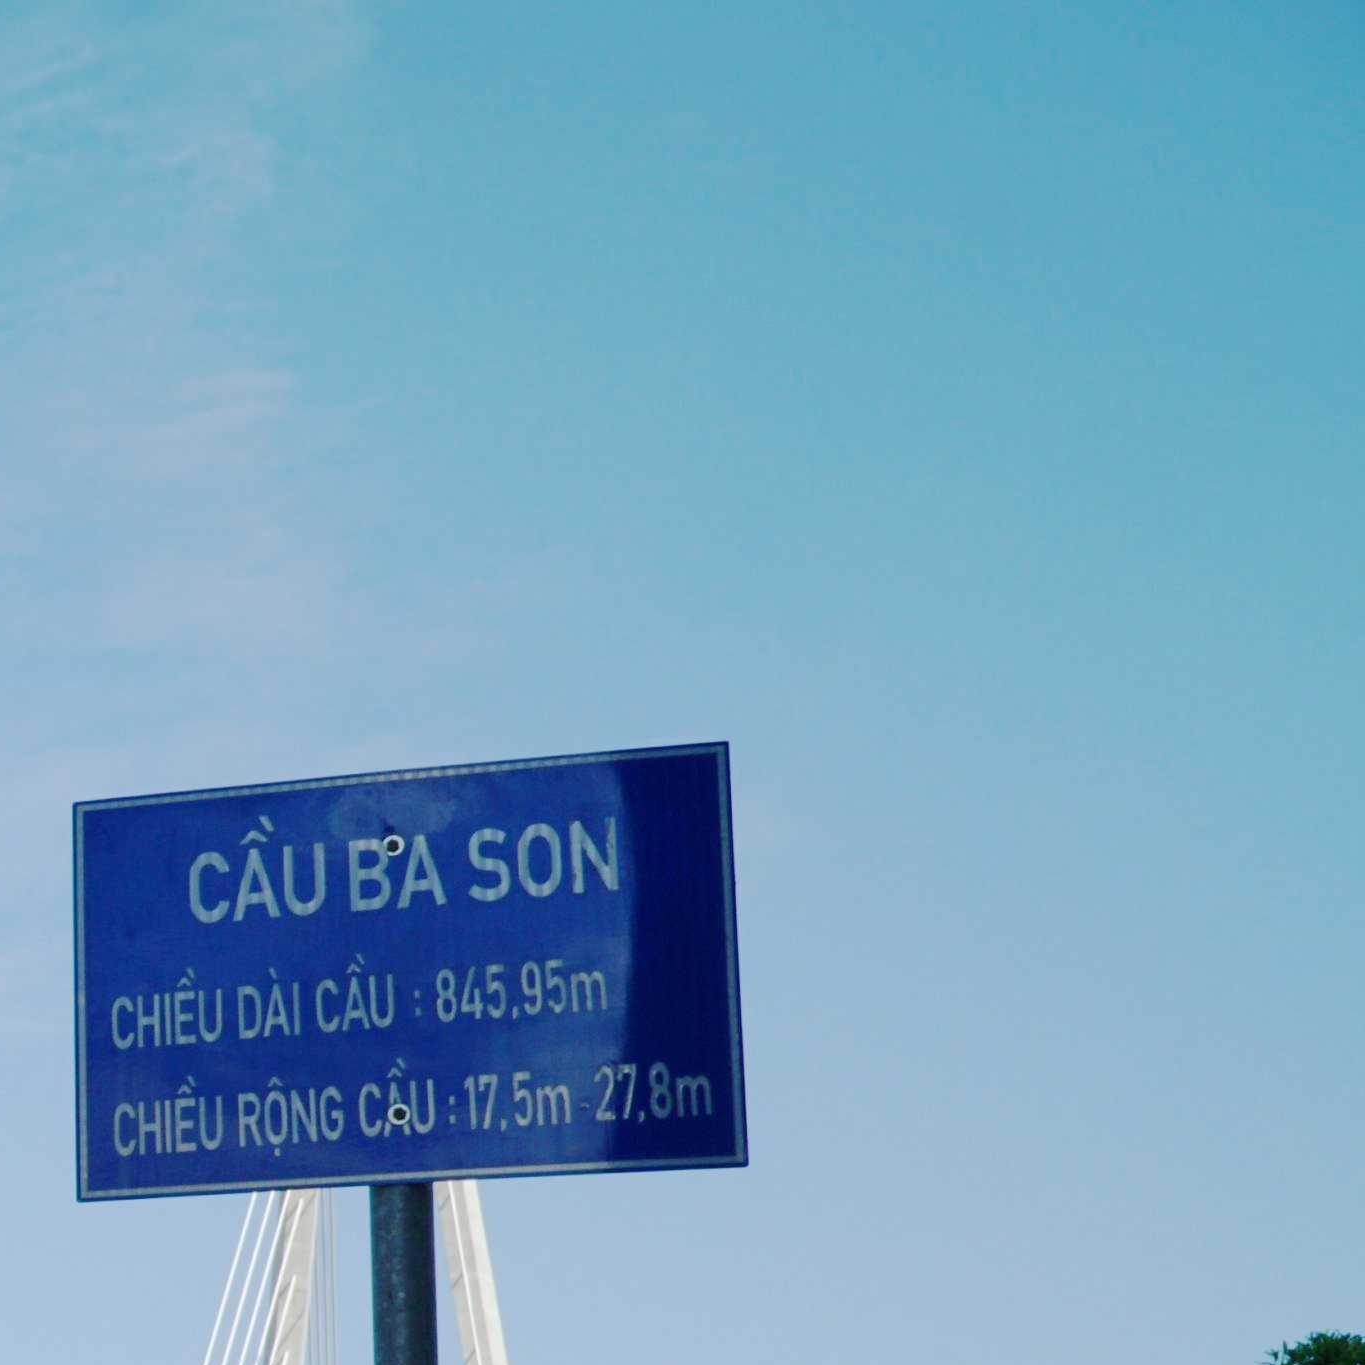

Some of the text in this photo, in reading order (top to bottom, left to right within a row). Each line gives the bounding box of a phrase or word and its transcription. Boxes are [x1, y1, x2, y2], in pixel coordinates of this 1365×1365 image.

[189, 815, 620, 924] CẦU BA SON
[111, 968, 223, 1050] CHIỀU
[237, 968, 302, 1041] DÀI
[314, 953, 396, 1034] CẦU
[435, 958, 608, 1023] 845,95m
[113, 1075, 223, 1157] CHIỀU
[237, 1076, 345, 1157] RỘNG
[358, 1058, 436, 1139] CẦU
[463, 1070, 571, 1132] 17,5m
[593, 1061, 714, 1124] 27,8m
